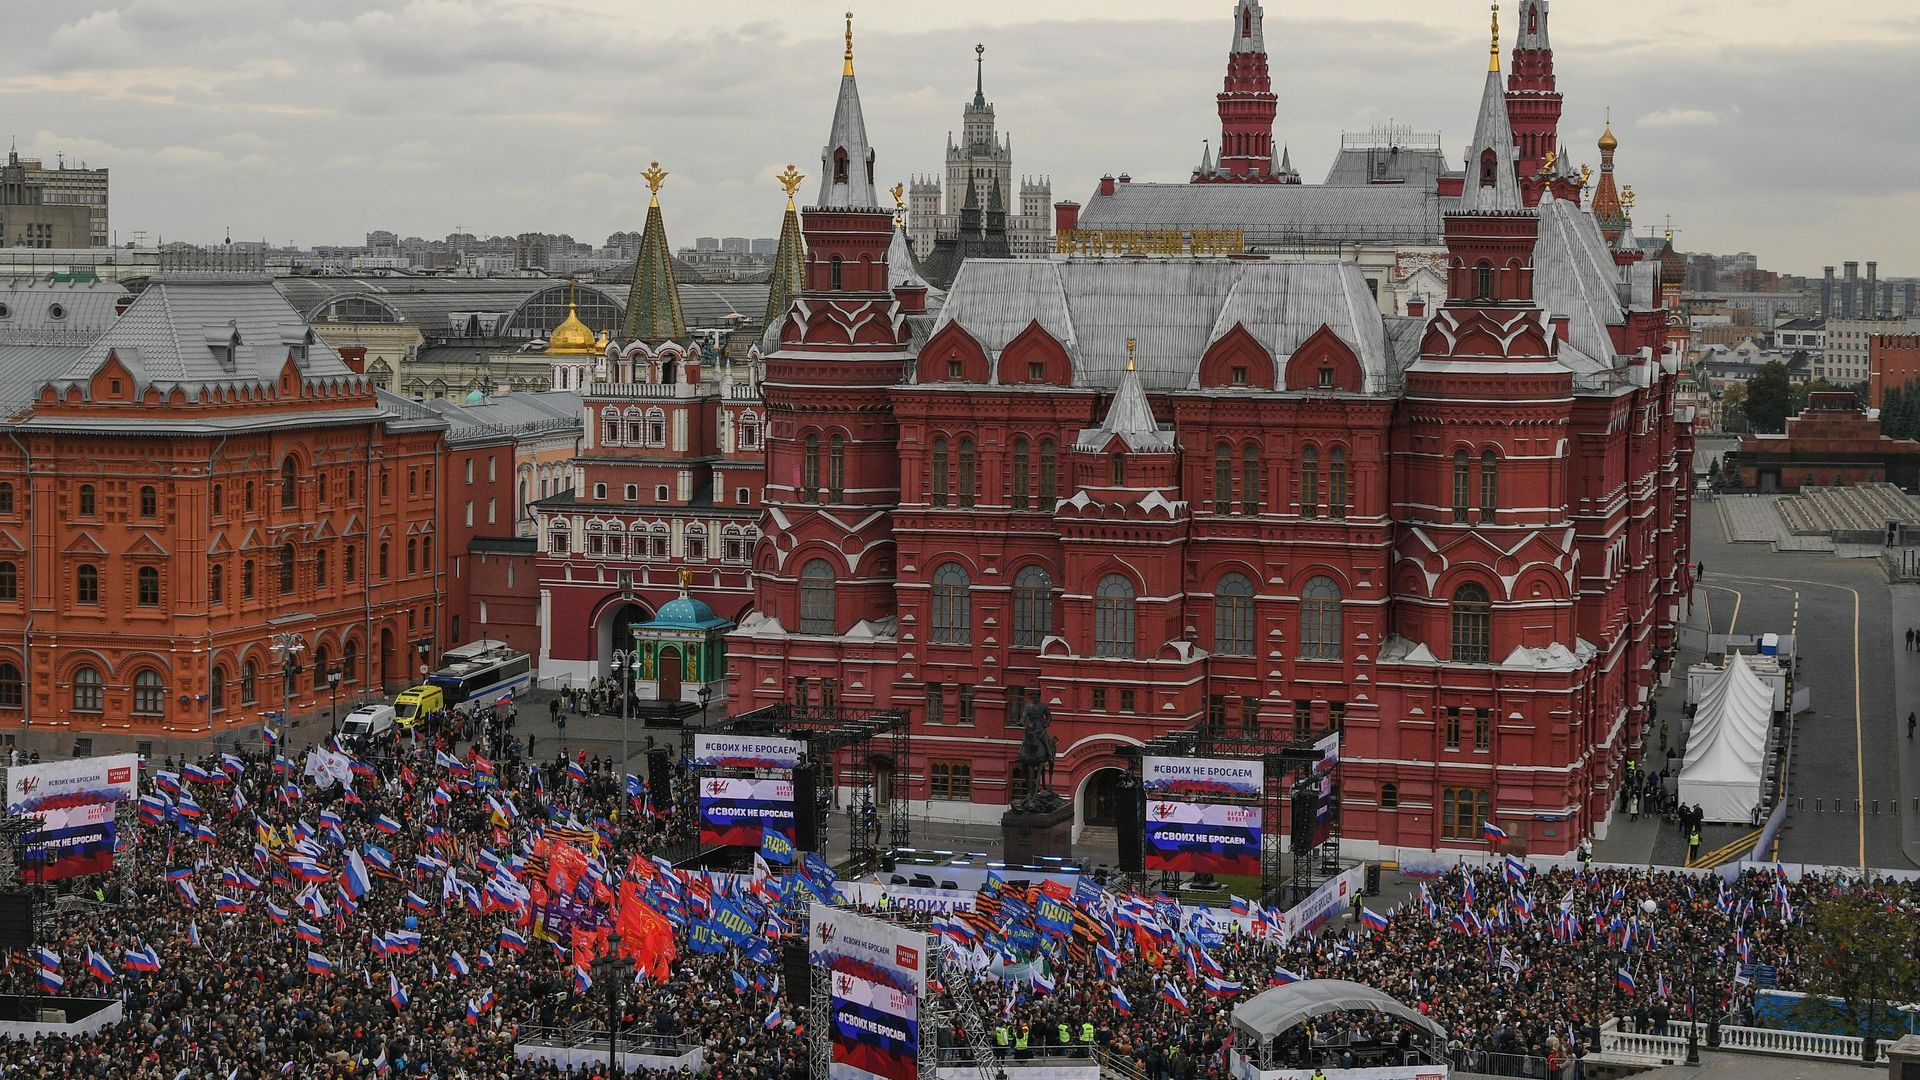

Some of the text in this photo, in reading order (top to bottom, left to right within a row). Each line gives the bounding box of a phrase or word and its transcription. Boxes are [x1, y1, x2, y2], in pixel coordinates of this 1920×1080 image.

[706, 742, 797, 754] #СВОИХ НЕ БРОСАЕМ
[1154, 764, 1252, 778] #СВОИХ НЕ БРОСАЕМ
[48, 778, 68, 786] #СВОИХ
[76, 775, 100, 784] БРОСАЕМ
[708, 806, 794, 818] #СВОИХ НЕ БРОСАЕМ
[62, 838, 72, 846] НЕ
[72, 834, 102, 845] БРОСАЕМ
[1154, 831, 1246, 845] #СВОИХ НЕ БРОСАЕМ
[888, 896, 971, 913] #СВОИХ НЕ
[1038, 901, 1074, 924] ЛДПР
[716, 908, 753, 936] ЛДПР
[843, 935, 890, 955] #СВОИХ НЕ БРОСАЕМ
[838, 1011, 906, 1042] #СВОИХ НЕ БРОСАЕМ
